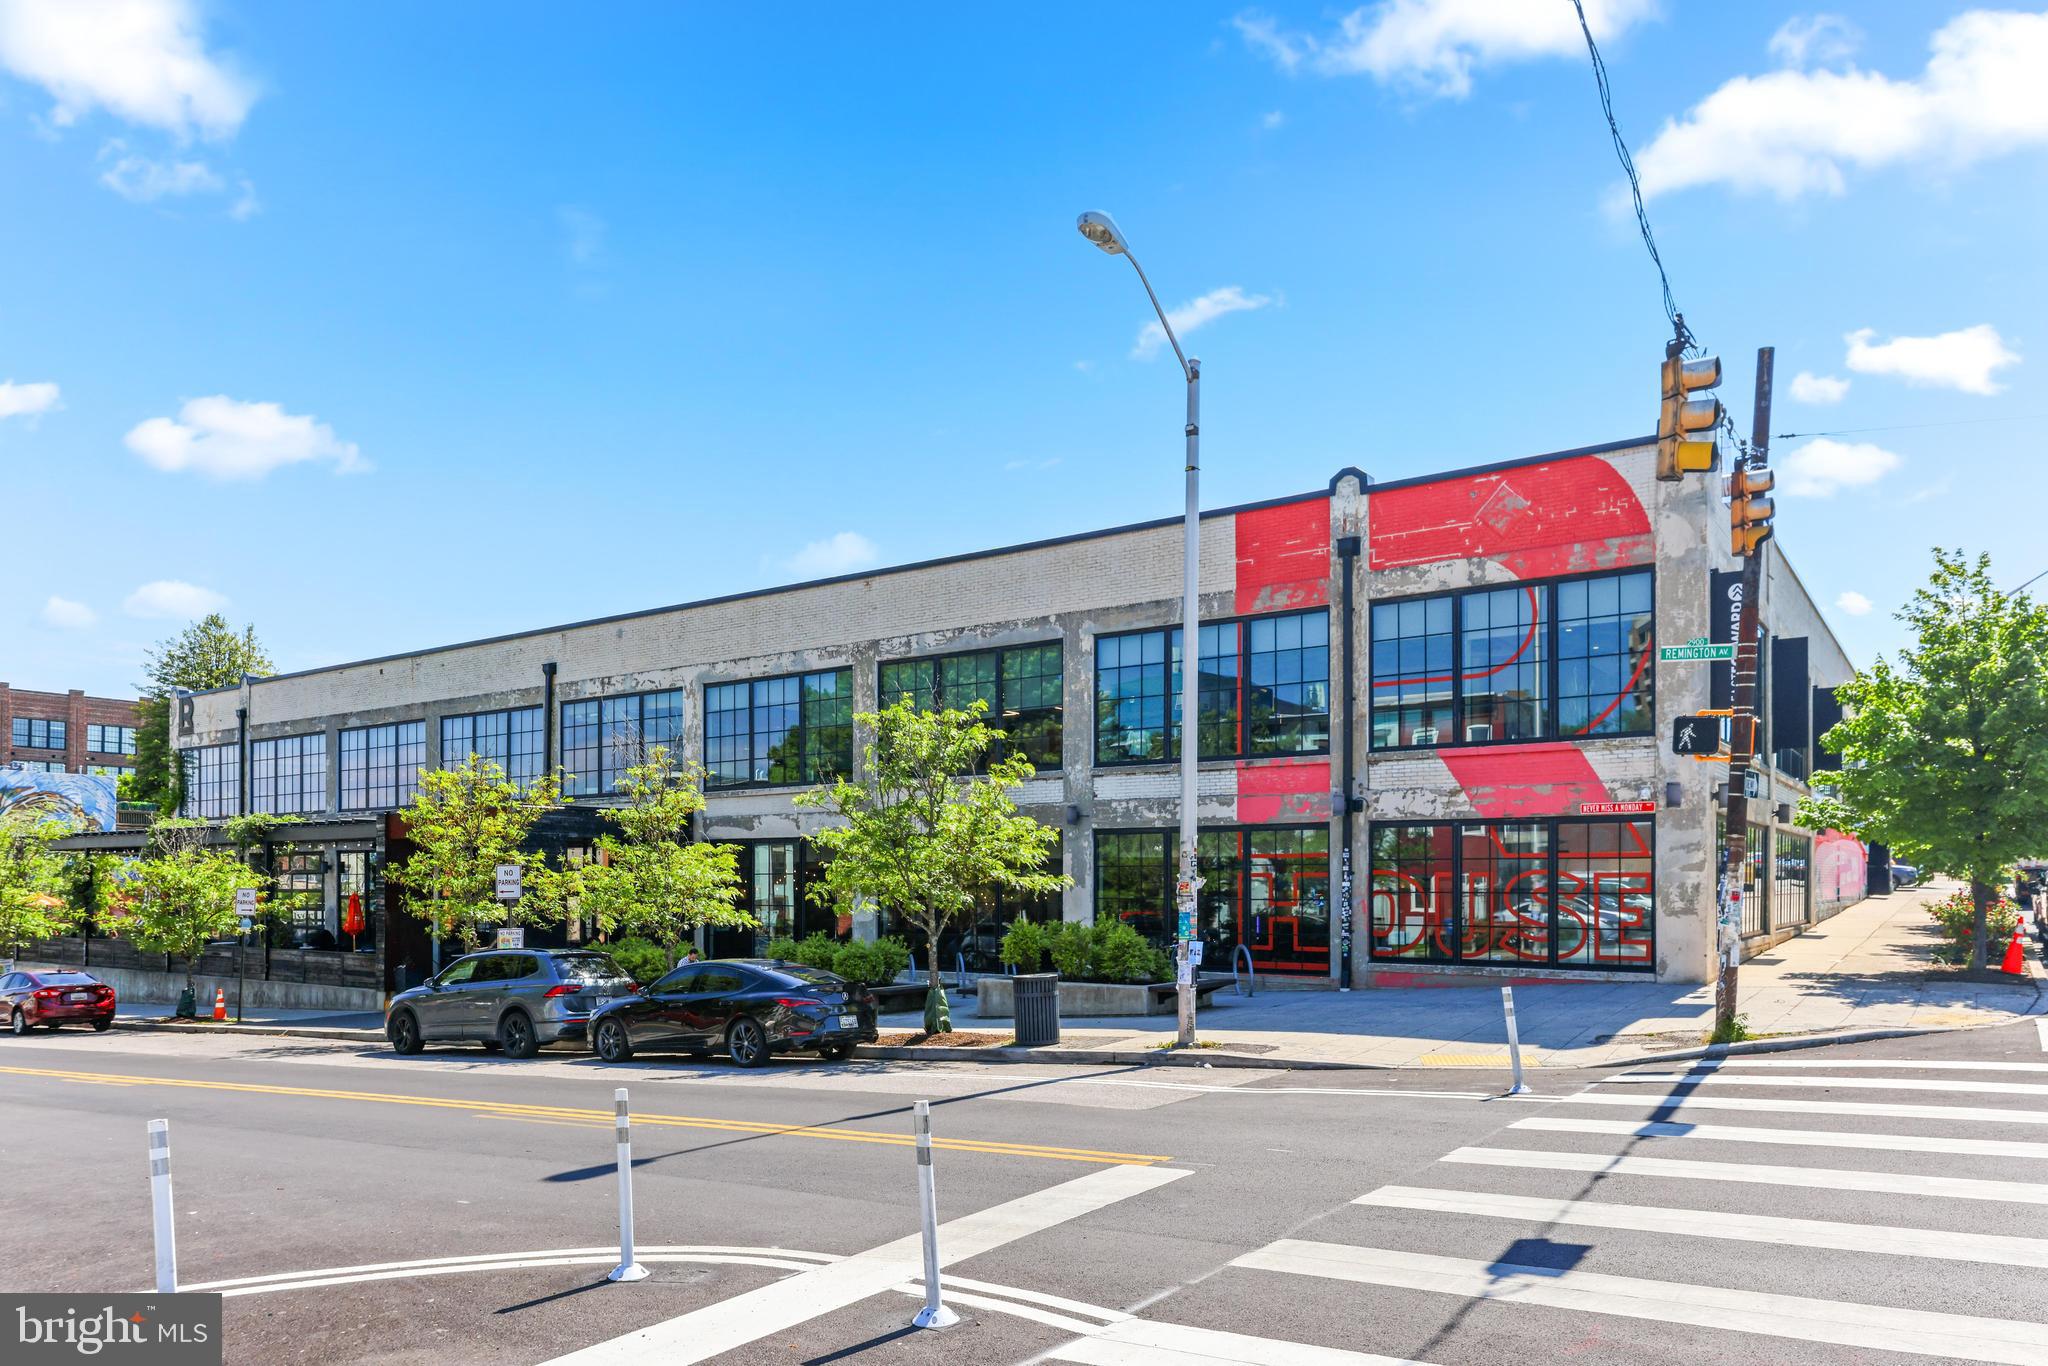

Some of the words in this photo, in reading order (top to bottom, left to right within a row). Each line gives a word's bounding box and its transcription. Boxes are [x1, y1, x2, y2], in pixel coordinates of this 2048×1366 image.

[1665, 647, 1716, 659] REMINGTON
[1583, 804, 1600, 813] NEVER
[1614, 804, 1619, 812] A
[1620, 803, 1643, 811] MONDAY
